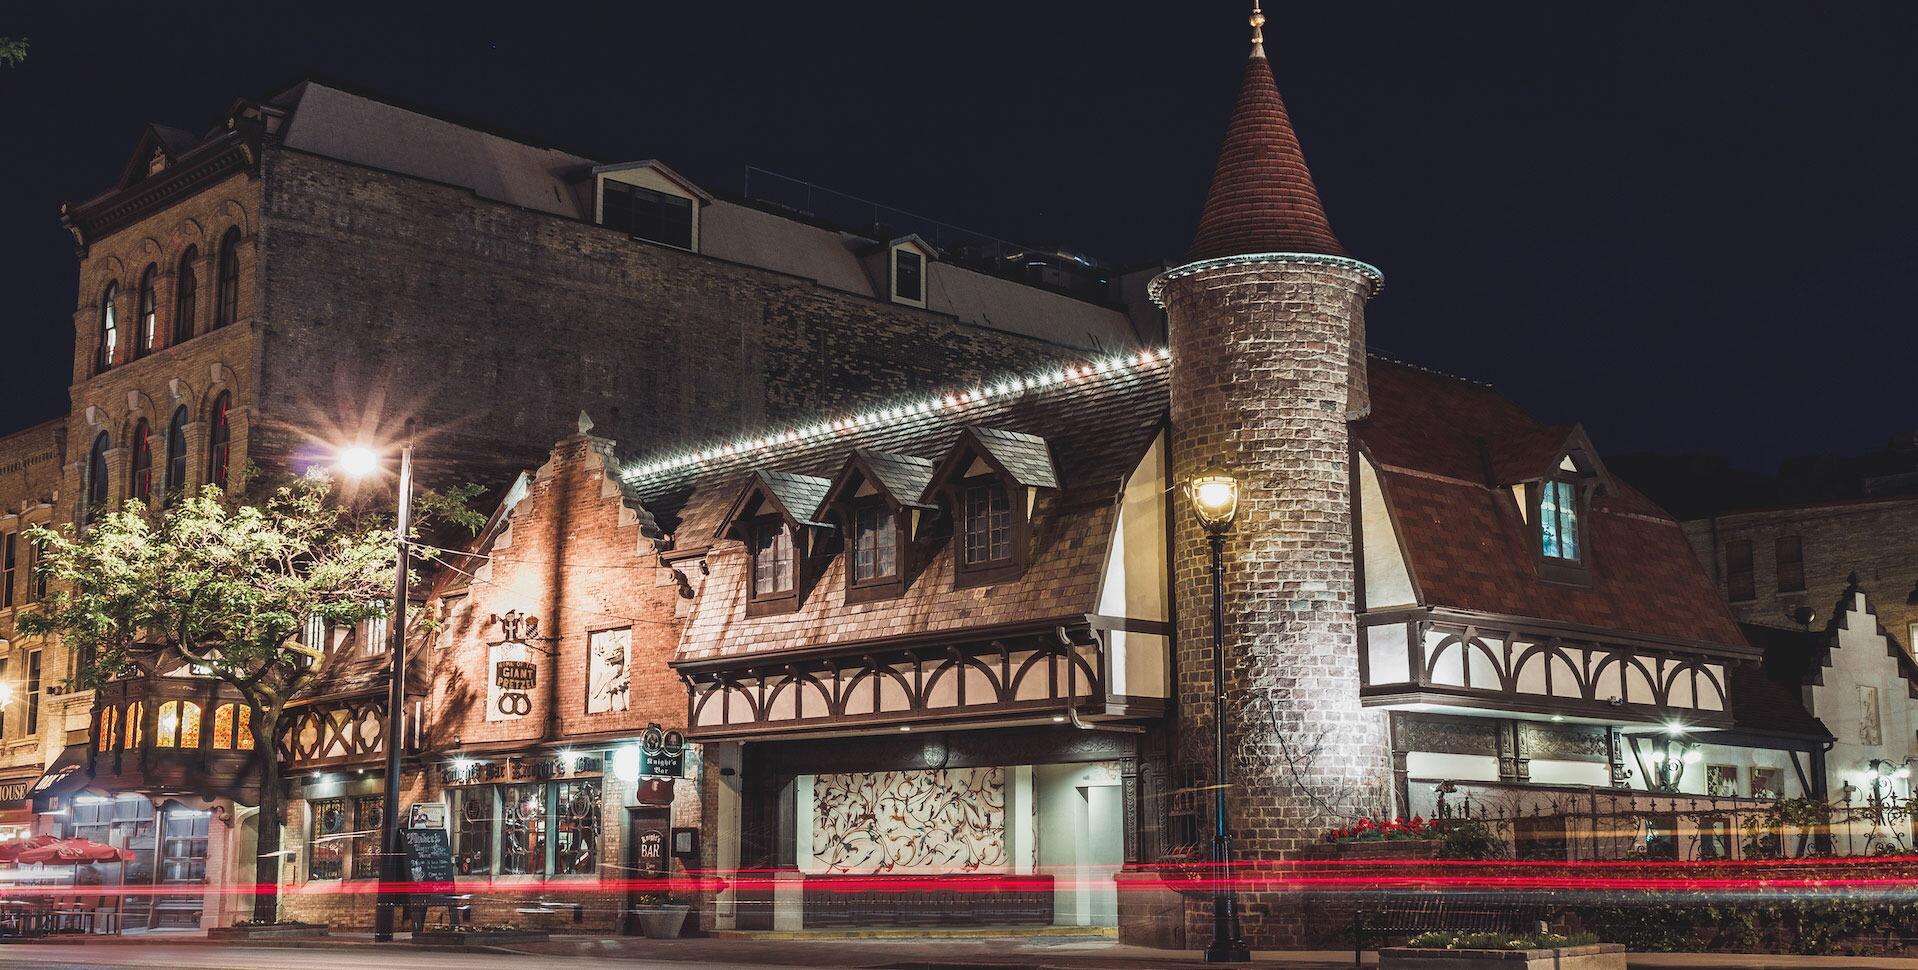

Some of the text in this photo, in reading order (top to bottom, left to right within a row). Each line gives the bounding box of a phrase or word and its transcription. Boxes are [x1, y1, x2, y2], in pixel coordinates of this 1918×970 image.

[502, 667, 533, 679] GIANT
[497, 677, 535, 690] PRETZEL
[647, 758, 677, 767] Knight's
[641, 844, 660, 857] BAR
